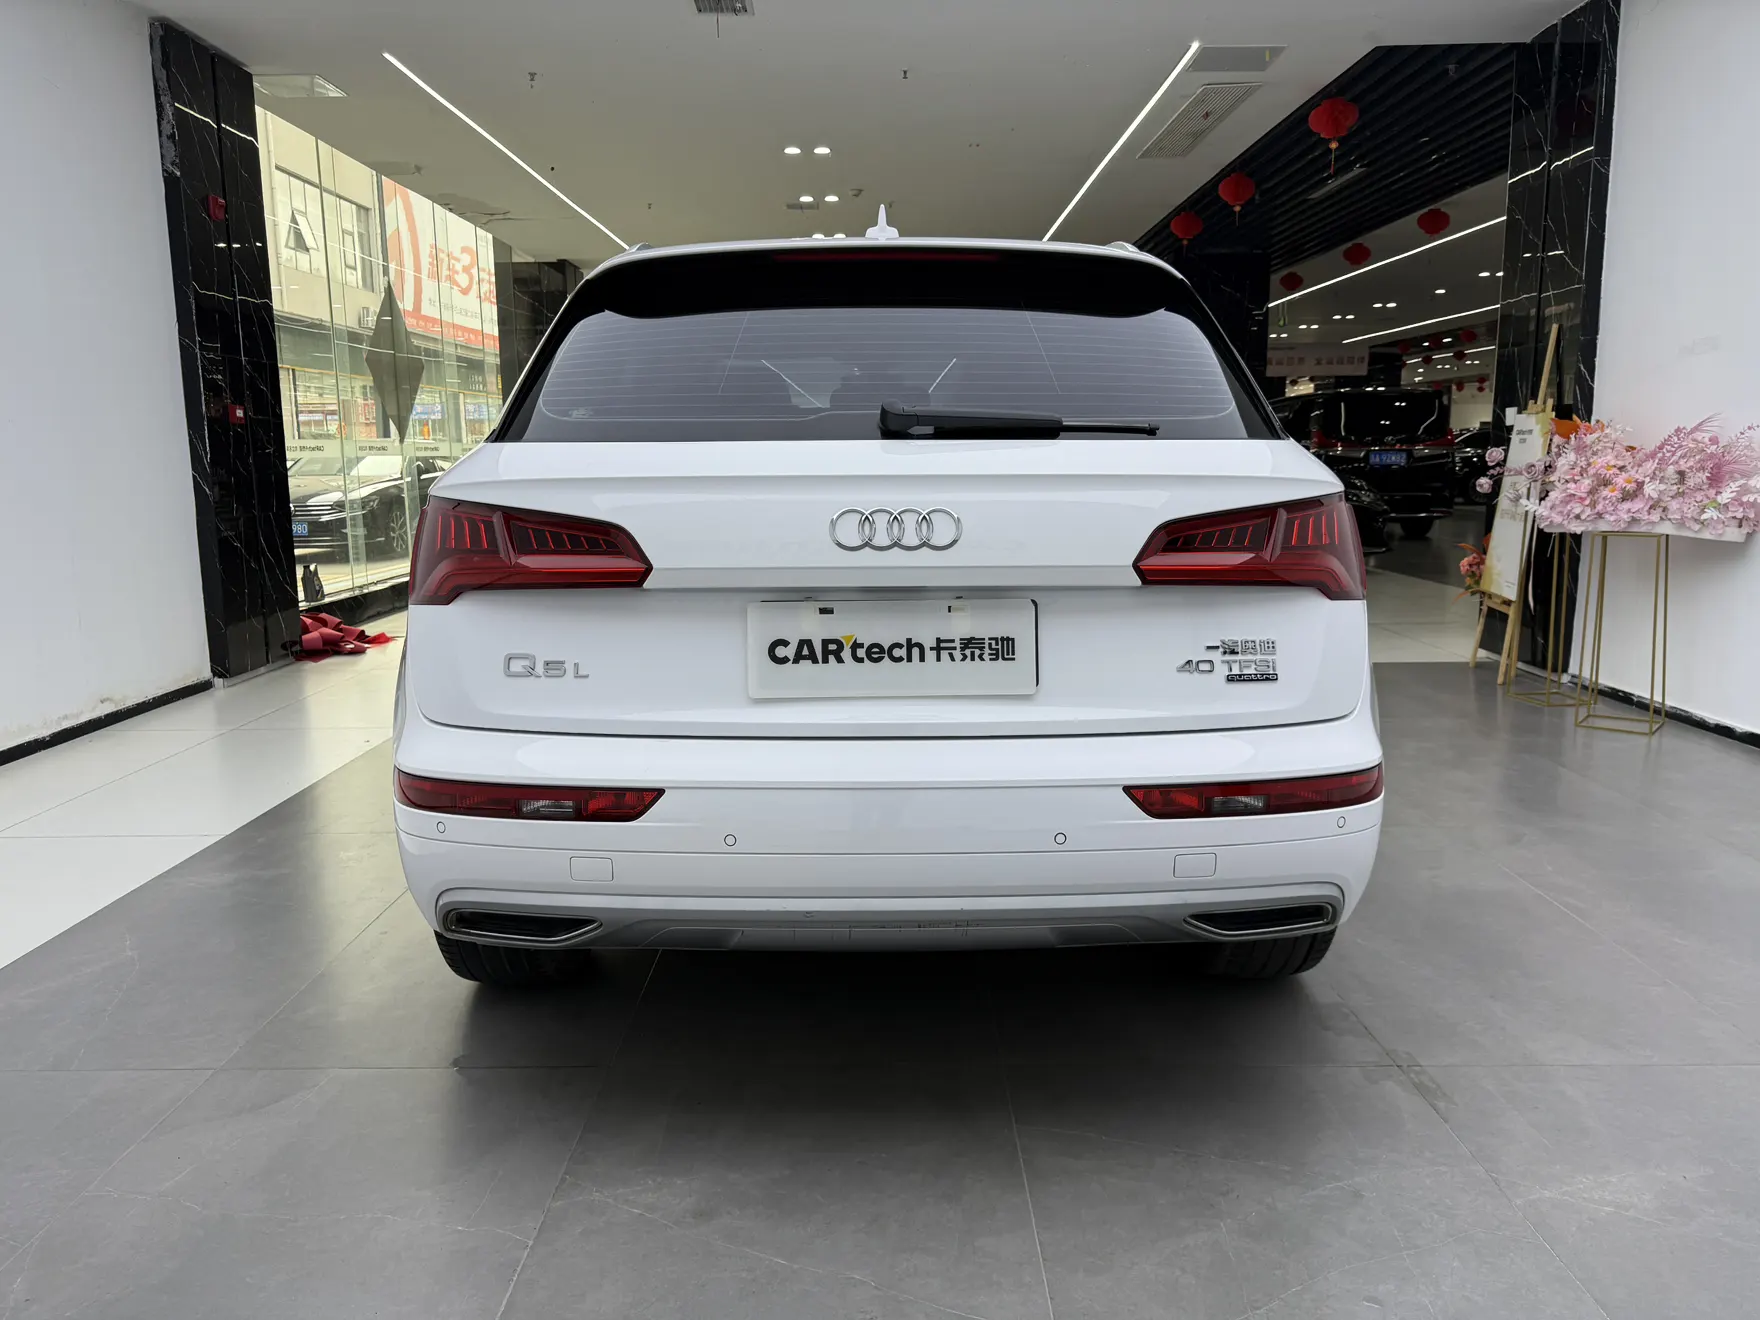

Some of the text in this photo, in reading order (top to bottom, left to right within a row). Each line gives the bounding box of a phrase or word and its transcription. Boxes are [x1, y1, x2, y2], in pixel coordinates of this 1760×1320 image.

[1205, 639, 1276, 656] 一汽奥迪
[1176, 658, 1276, 673] 40 TFSI
[1227, 673, 1277, 681] quattro
